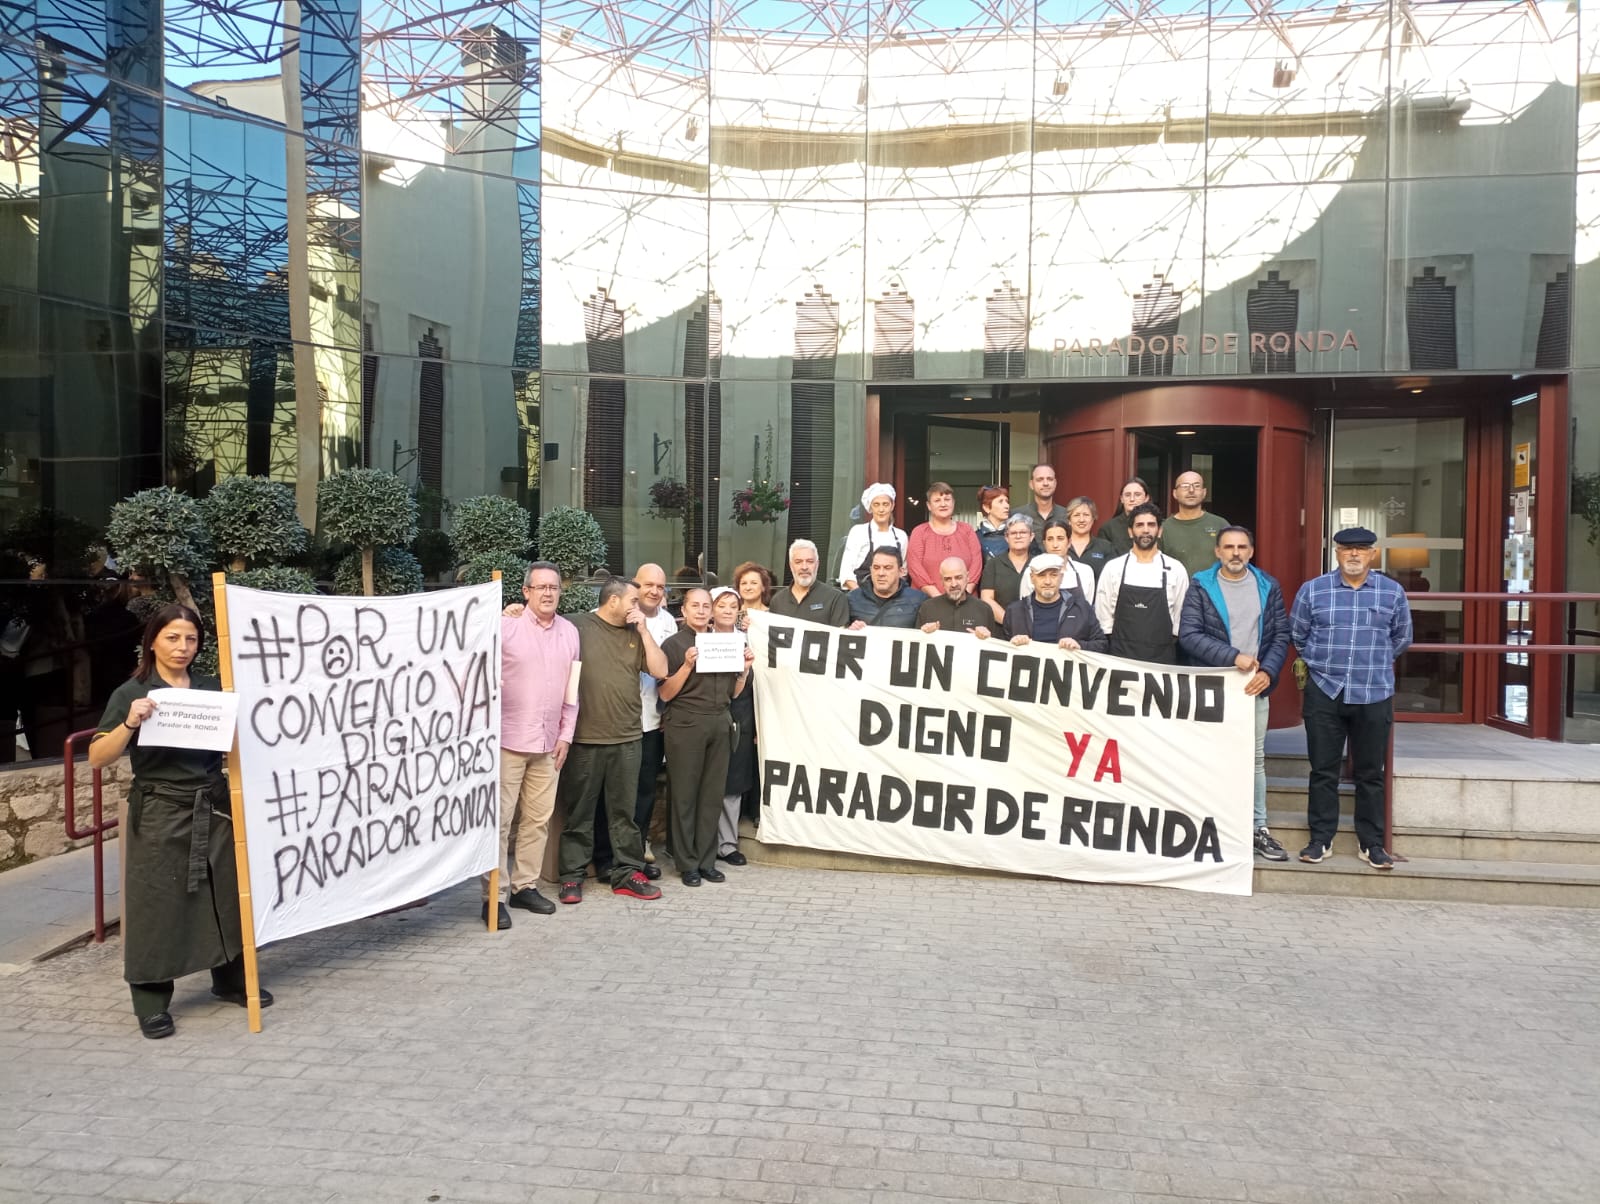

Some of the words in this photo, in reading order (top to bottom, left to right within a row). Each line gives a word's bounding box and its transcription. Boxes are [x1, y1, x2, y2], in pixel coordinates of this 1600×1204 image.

[1053, 333, 1189, 359] PARADOR
[1201, 333, 1239, 355] DE
[1250, 330, 1360, 354] RONDA
[416, 597, 480, 655] UN
[767, 625, 867, 681] POR
[889, 640, 954, 692] UN
[976, 649, 1225, 723] CONVENIO
[158, 710, 170, 718] en
[172, 711, 221, 722] #Paradores
[443, 634, 498, 741] YA!
[265, 734, 496, 836] #PARADORES
[858, 699, 1012, 763] DIGNO
[1063, 731, 1123, 784] YA
[273, 806, 420, 910] PARADOR
[432, 781, 497, 842] RONDA
[762, 759, 976, 834] PARADOR
[984, 788, 1049, 841] DE
[1059, 797, 1223, 863] RONDA
